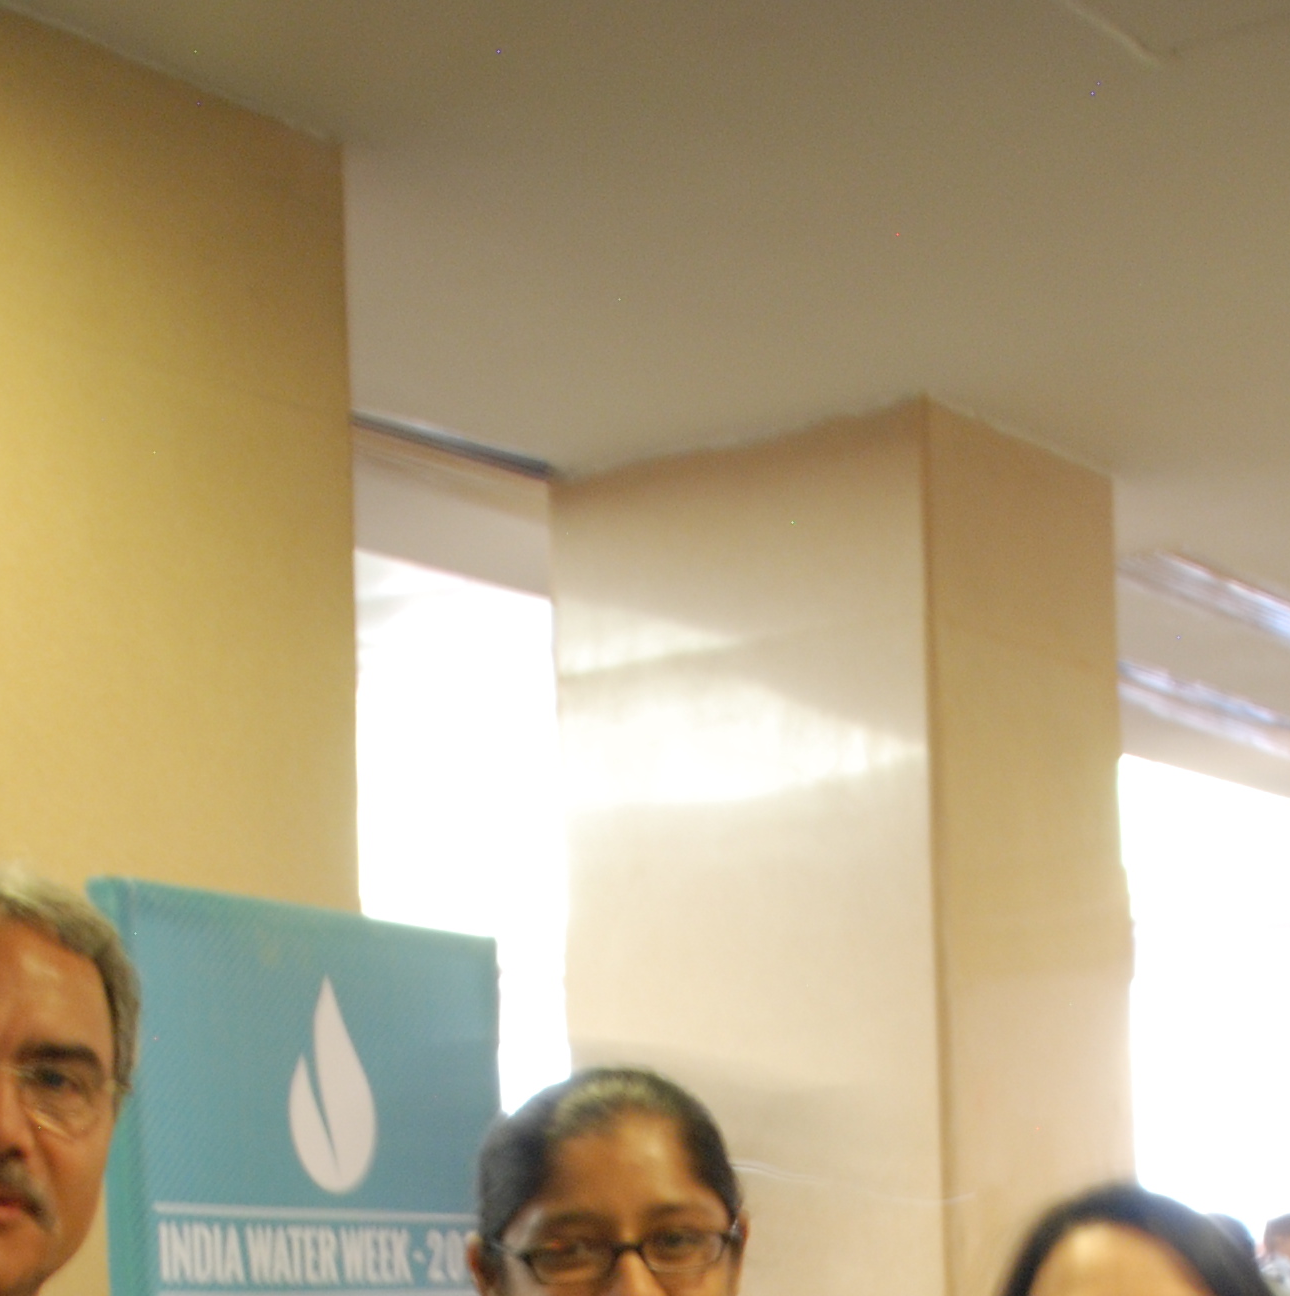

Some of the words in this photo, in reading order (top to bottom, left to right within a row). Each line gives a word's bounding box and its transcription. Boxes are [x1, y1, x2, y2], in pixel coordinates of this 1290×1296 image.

[159, 1219, 246, 1285] INDIA
[245, 1223, 340, 1286] WATER
[339, 1225, 412, 1286] WEEK
[426, 1229, 476, 1283] 20
